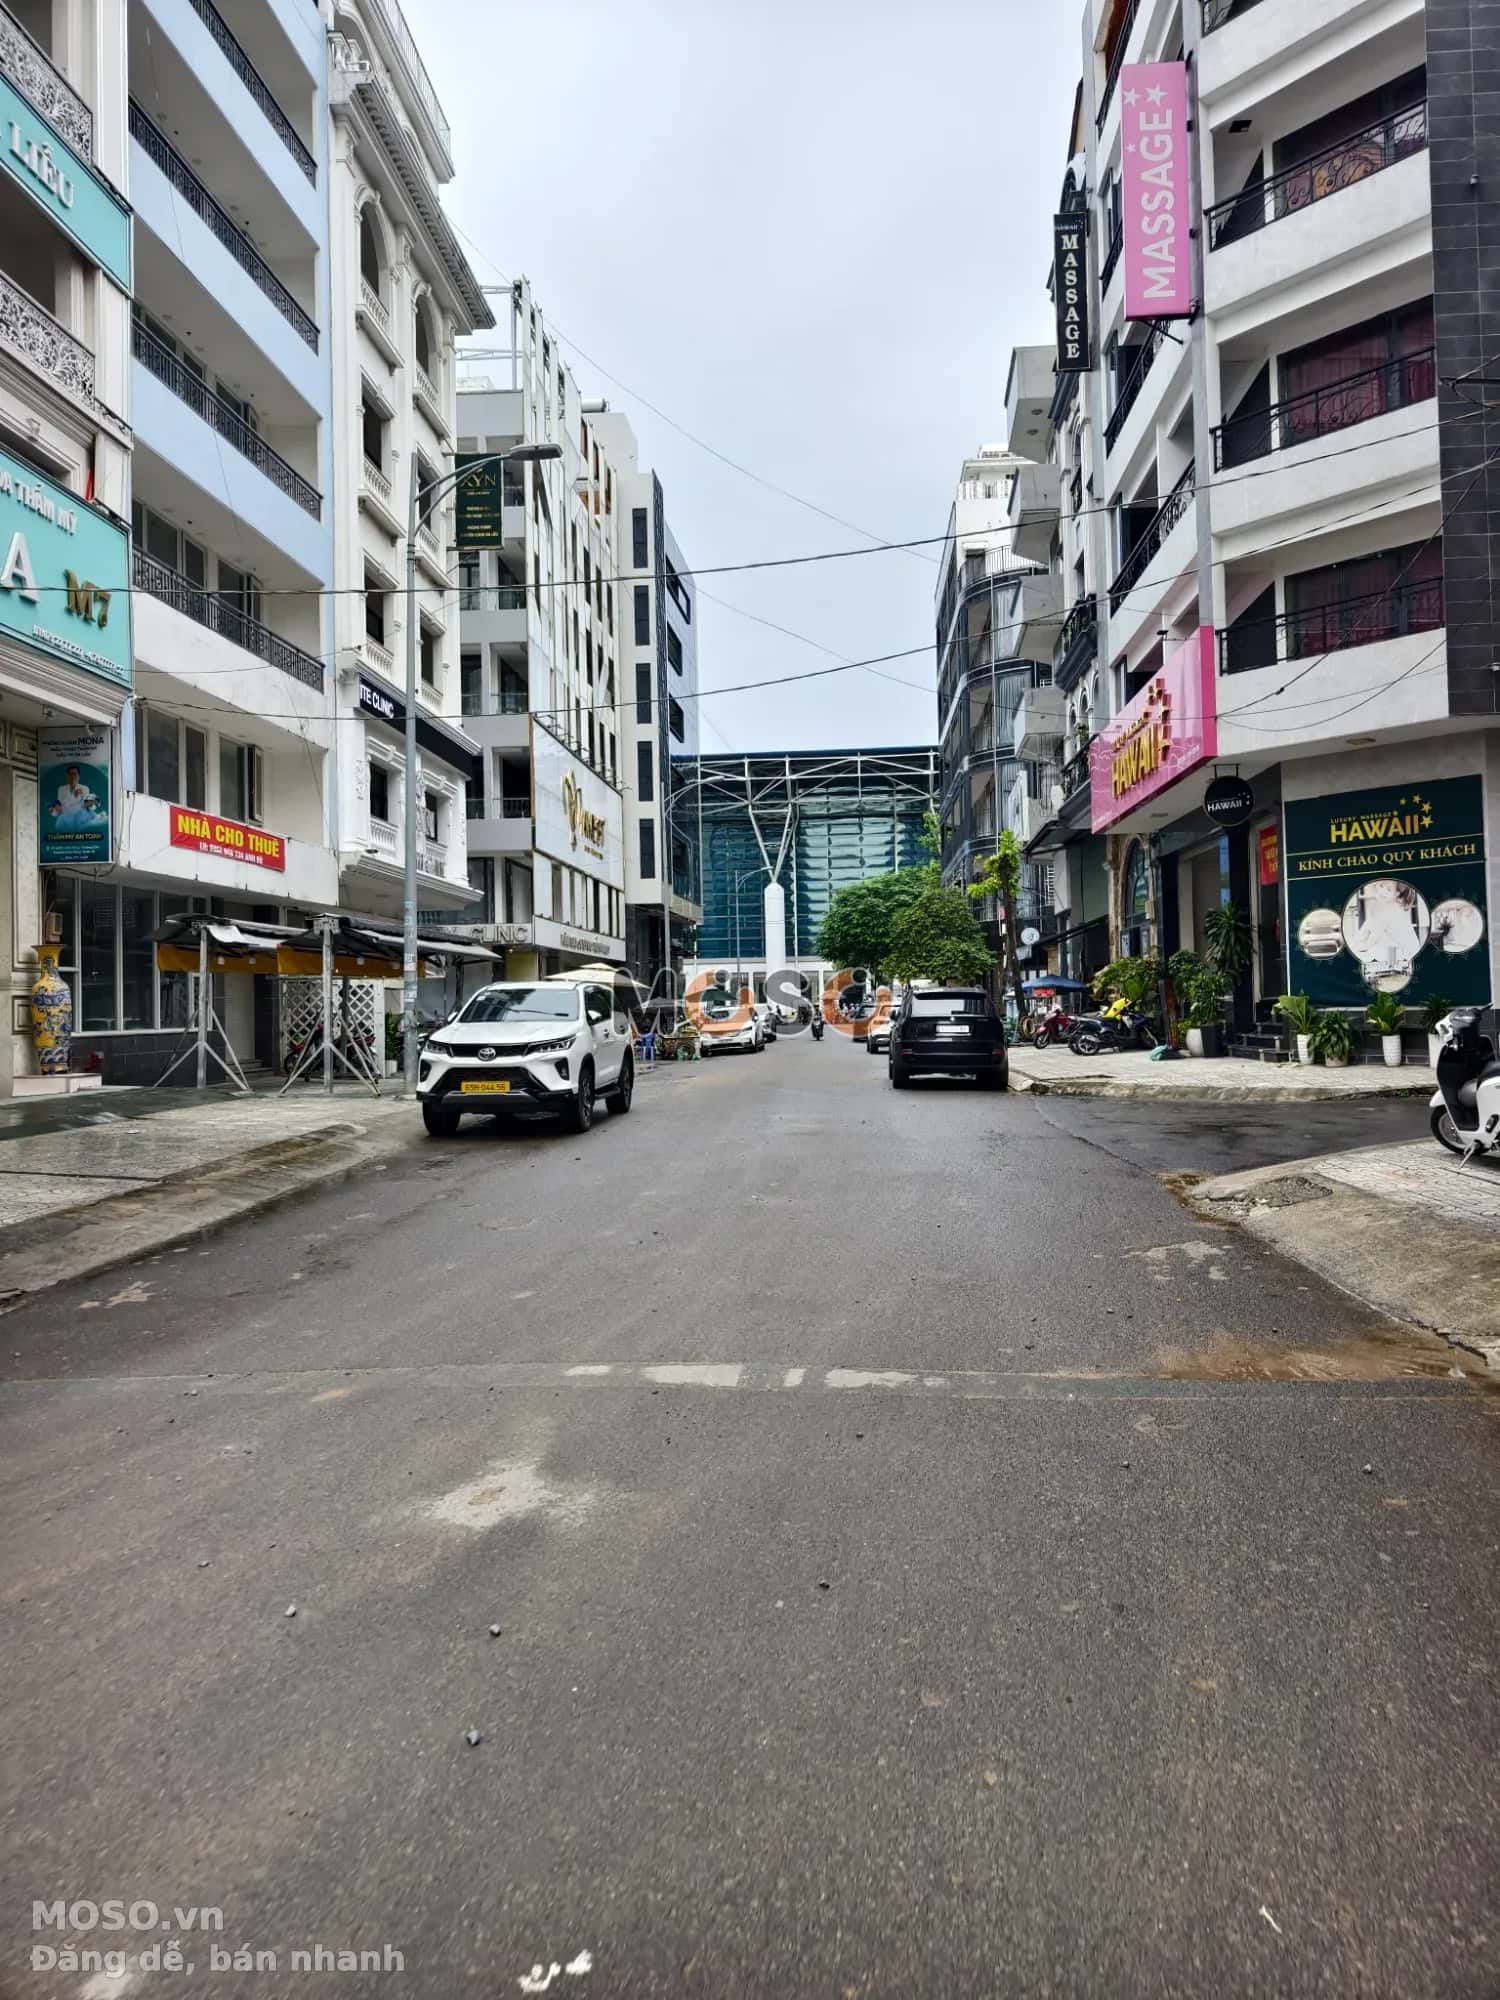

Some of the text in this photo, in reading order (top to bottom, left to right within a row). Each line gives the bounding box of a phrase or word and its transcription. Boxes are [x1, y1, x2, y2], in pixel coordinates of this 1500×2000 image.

[1138, 108, 1177, 298] MASSAGE
[1061, 233, 1081, 359] MASSAGE
[1111, 723, 1161, 799] HAWAII
[1207, 799, 1243, 812] HAWAII
[1360, 810, 1393, 820] MASSAGE
[177, 814, 211, 840] NHÀ
[215, 824, 244, 848] CHO
[247, 833, 281, 857] THUÊ
[1330, 814, 1419, 844] HAWAII
[1299, 857, 1333, 871] KÍNH
[1336, 852, 1378, 868] CHÀO
[1420, 843, 1476, 859] KHÁCH
